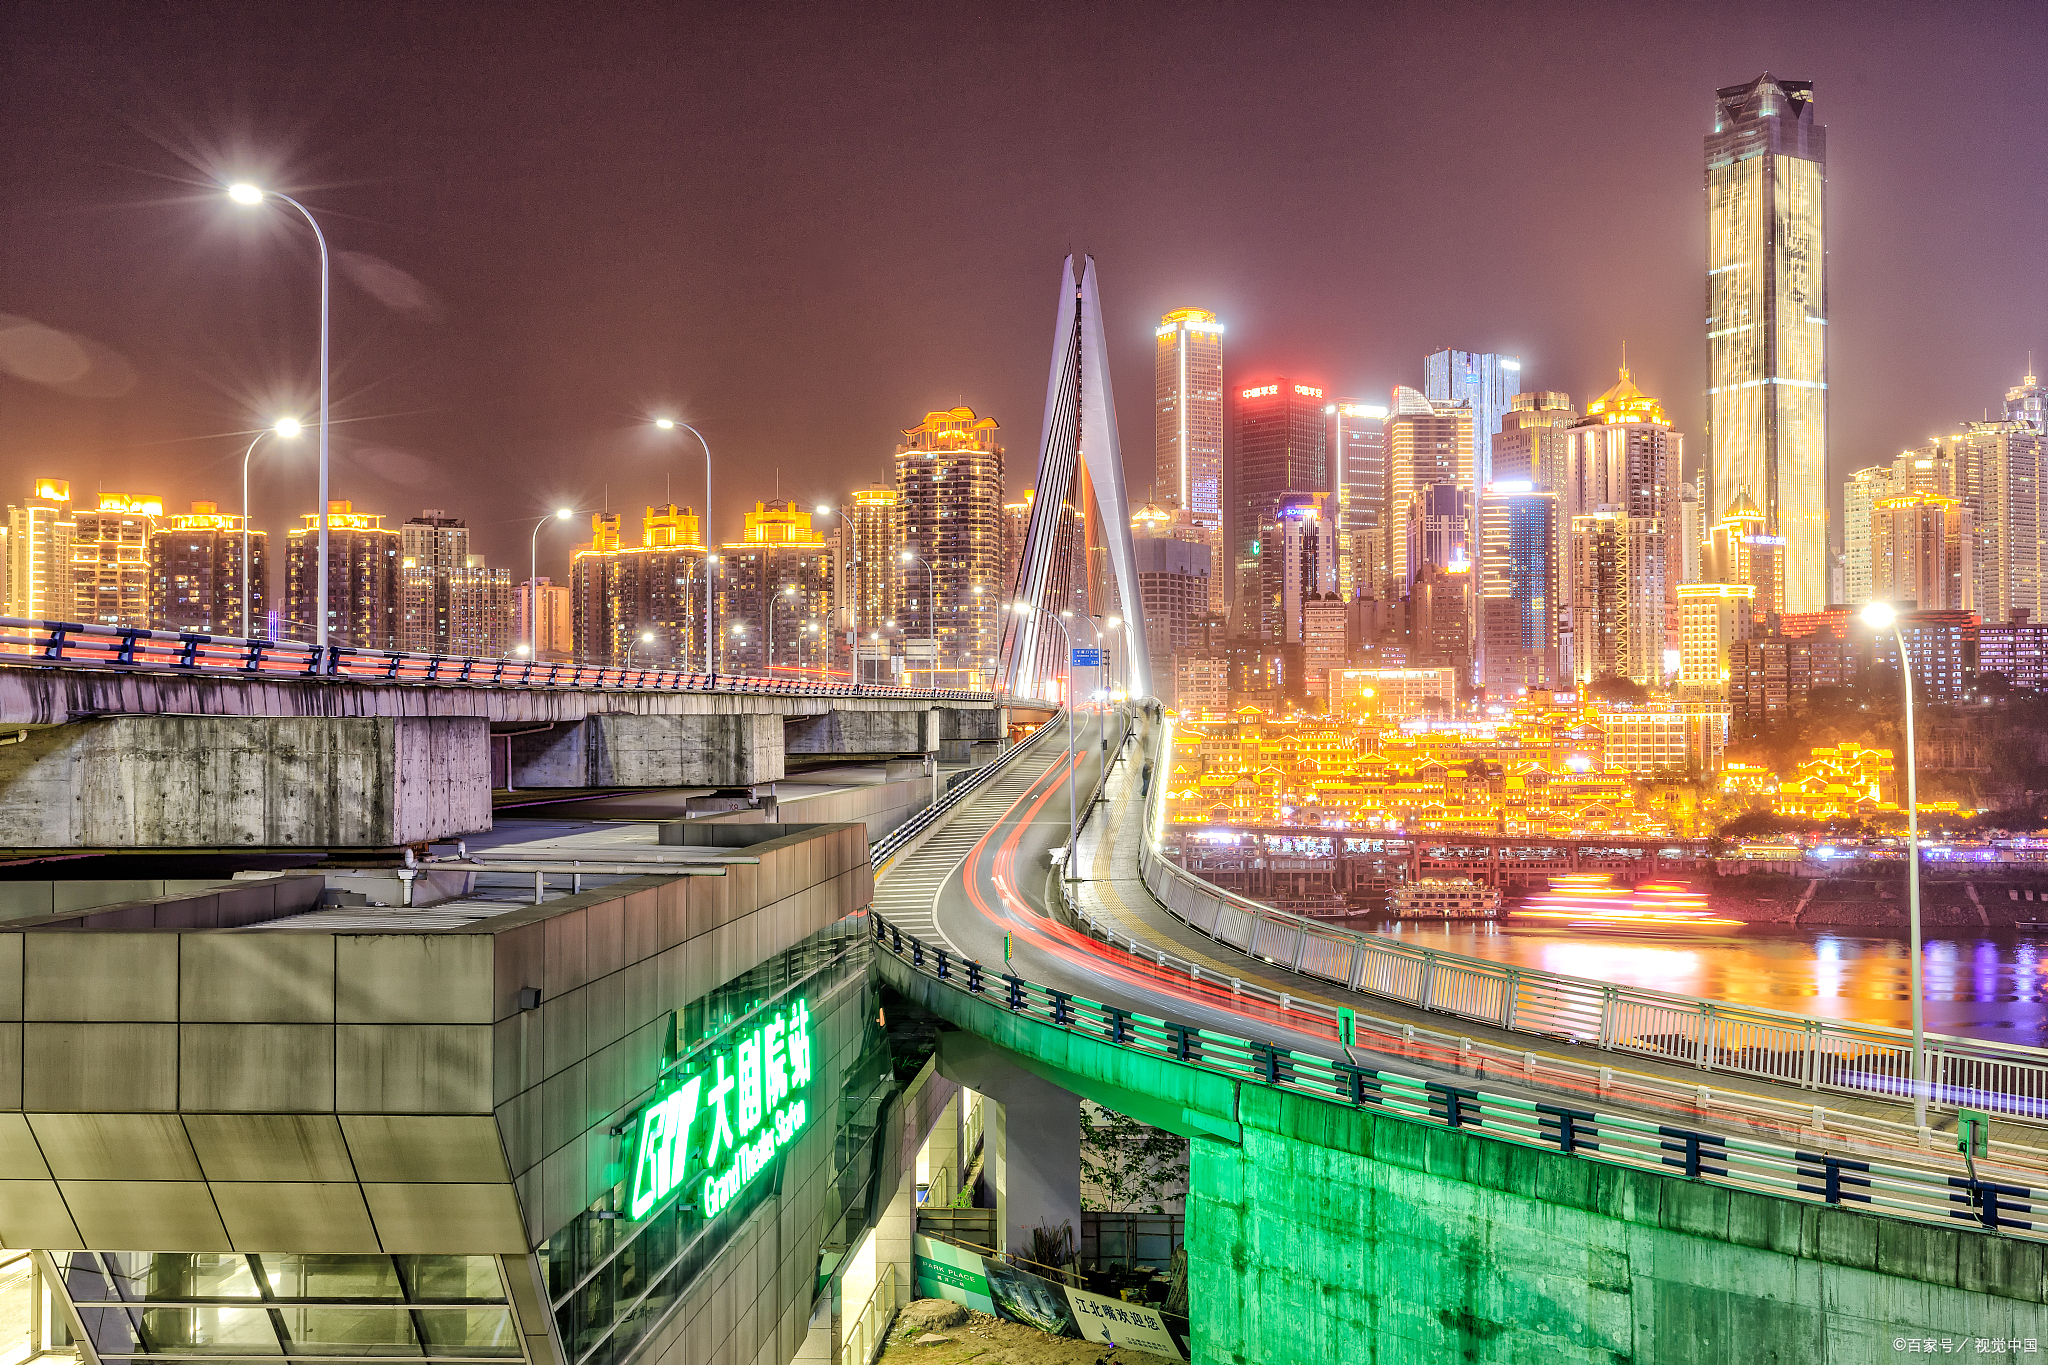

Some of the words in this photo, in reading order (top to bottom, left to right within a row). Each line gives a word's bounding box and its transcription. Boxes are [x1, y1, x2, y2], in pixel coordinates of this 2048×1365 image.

[1243, 385, 1278, 399] 中国平安
[1295, 384, 1322, 398] 中国平安
[704, 1152, 740, 1218] Grand
[922, 1260, 945, 1273] PARK
[948, 1269, 976, 1283] PLACE
[1074, 1296, 1161, 1331] 江北嘴欢迎您
